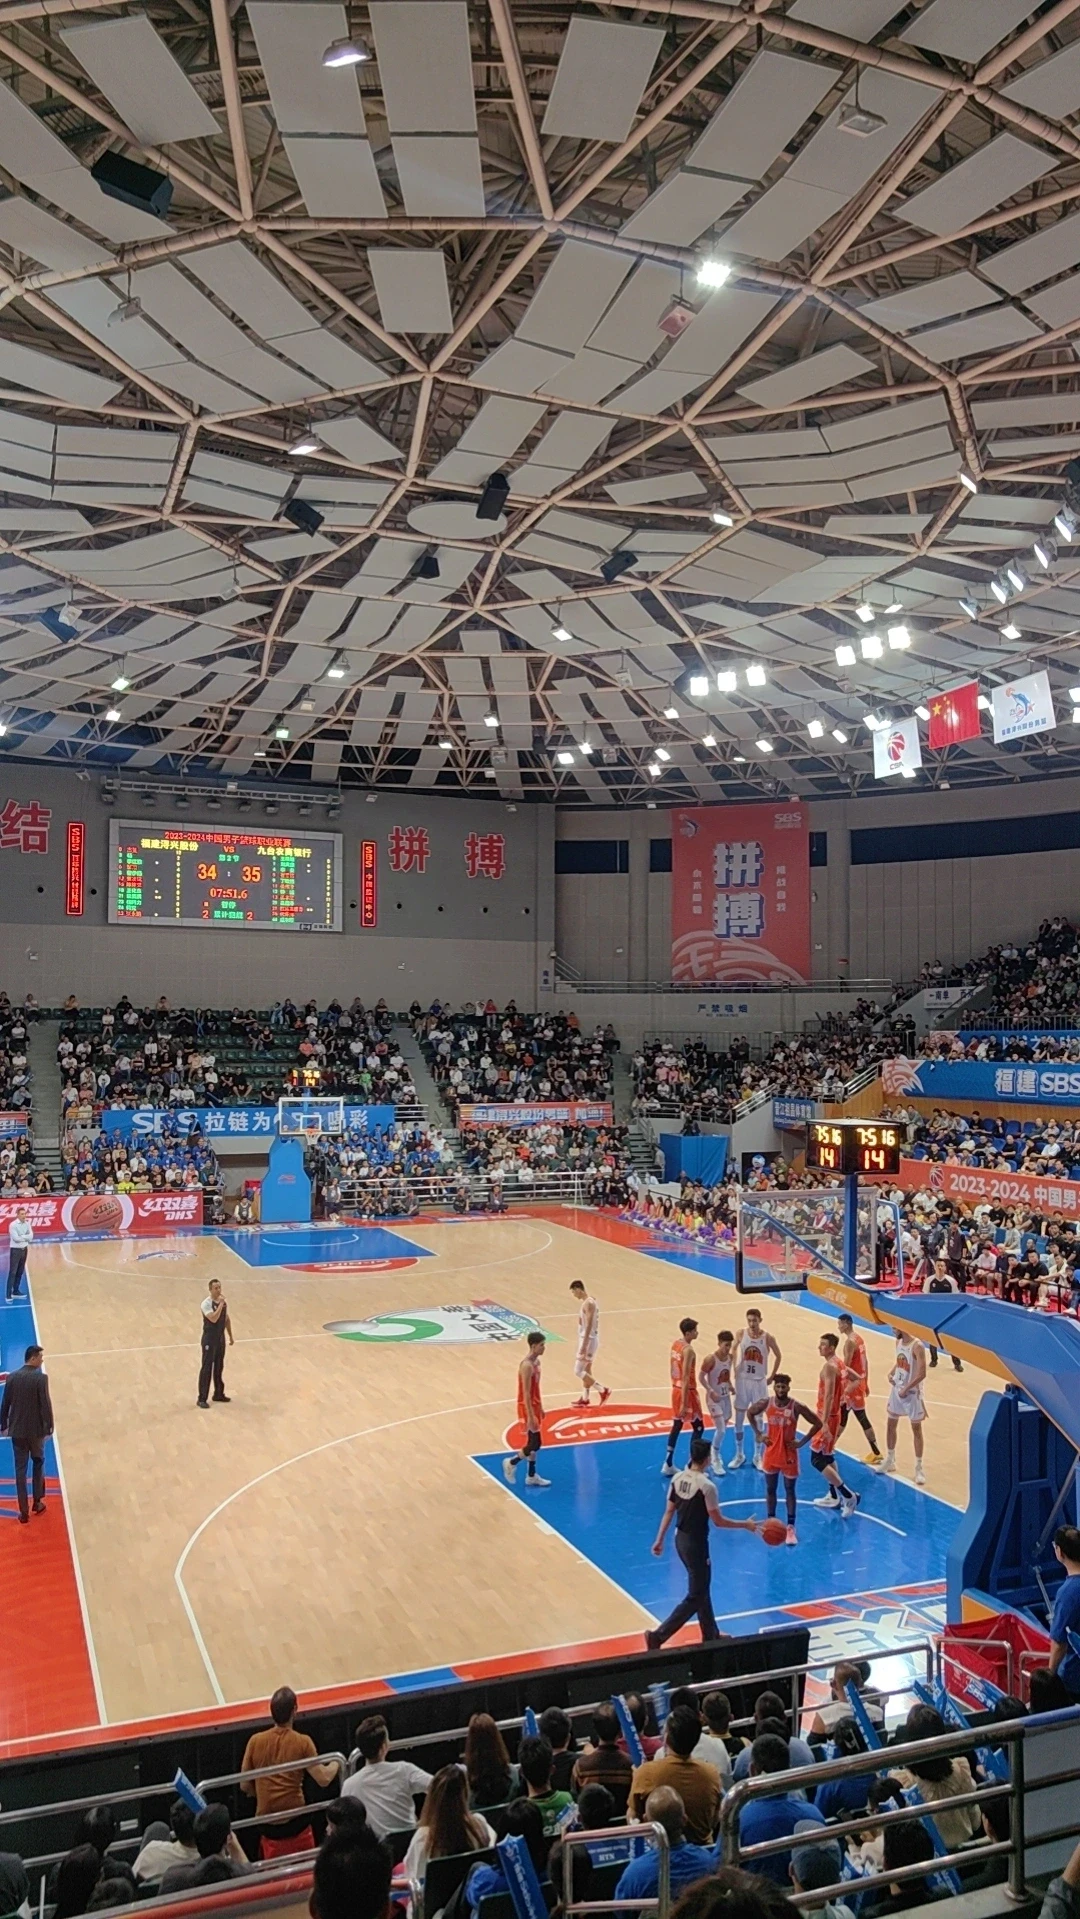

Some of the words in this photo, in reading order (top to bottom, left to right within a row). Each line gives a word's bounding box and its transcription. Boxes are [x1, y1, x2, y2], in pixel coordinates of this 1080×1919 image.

[0, 799, 51, 854] 结
[365, 846, 373, 868] SBS
[198, 863, 217, 880] 34
[242, 865, 261, 882] 35
[210, 888, 248, 899] 07:51.6
[714, 842, 765, 938] 拼搏
[202, 910, 209, 919] 2
[247, 911, 254, 920] 2
[697, 1004, 748, 1013] 严禁吸烟
[995, 1069, 1037, 1096] 福建
[1040, 1072, 1080, 1097] SBS
[820, 1147, 834, 1166] 14
[865, 1150, 884, 1169] 14
[950, 1173, 1030, 1200] 2023-2024
[1034, 1184, 1080, 1210] 中国男
[139, 1195, 199, 1218] 红双喜
[165, 1210, 197, 1221] DHS
[746, 1365, 756, 1374] 36
[555, 1420, 674, 1440] LI-NING
[680, 1480, 692, 1494] 101
